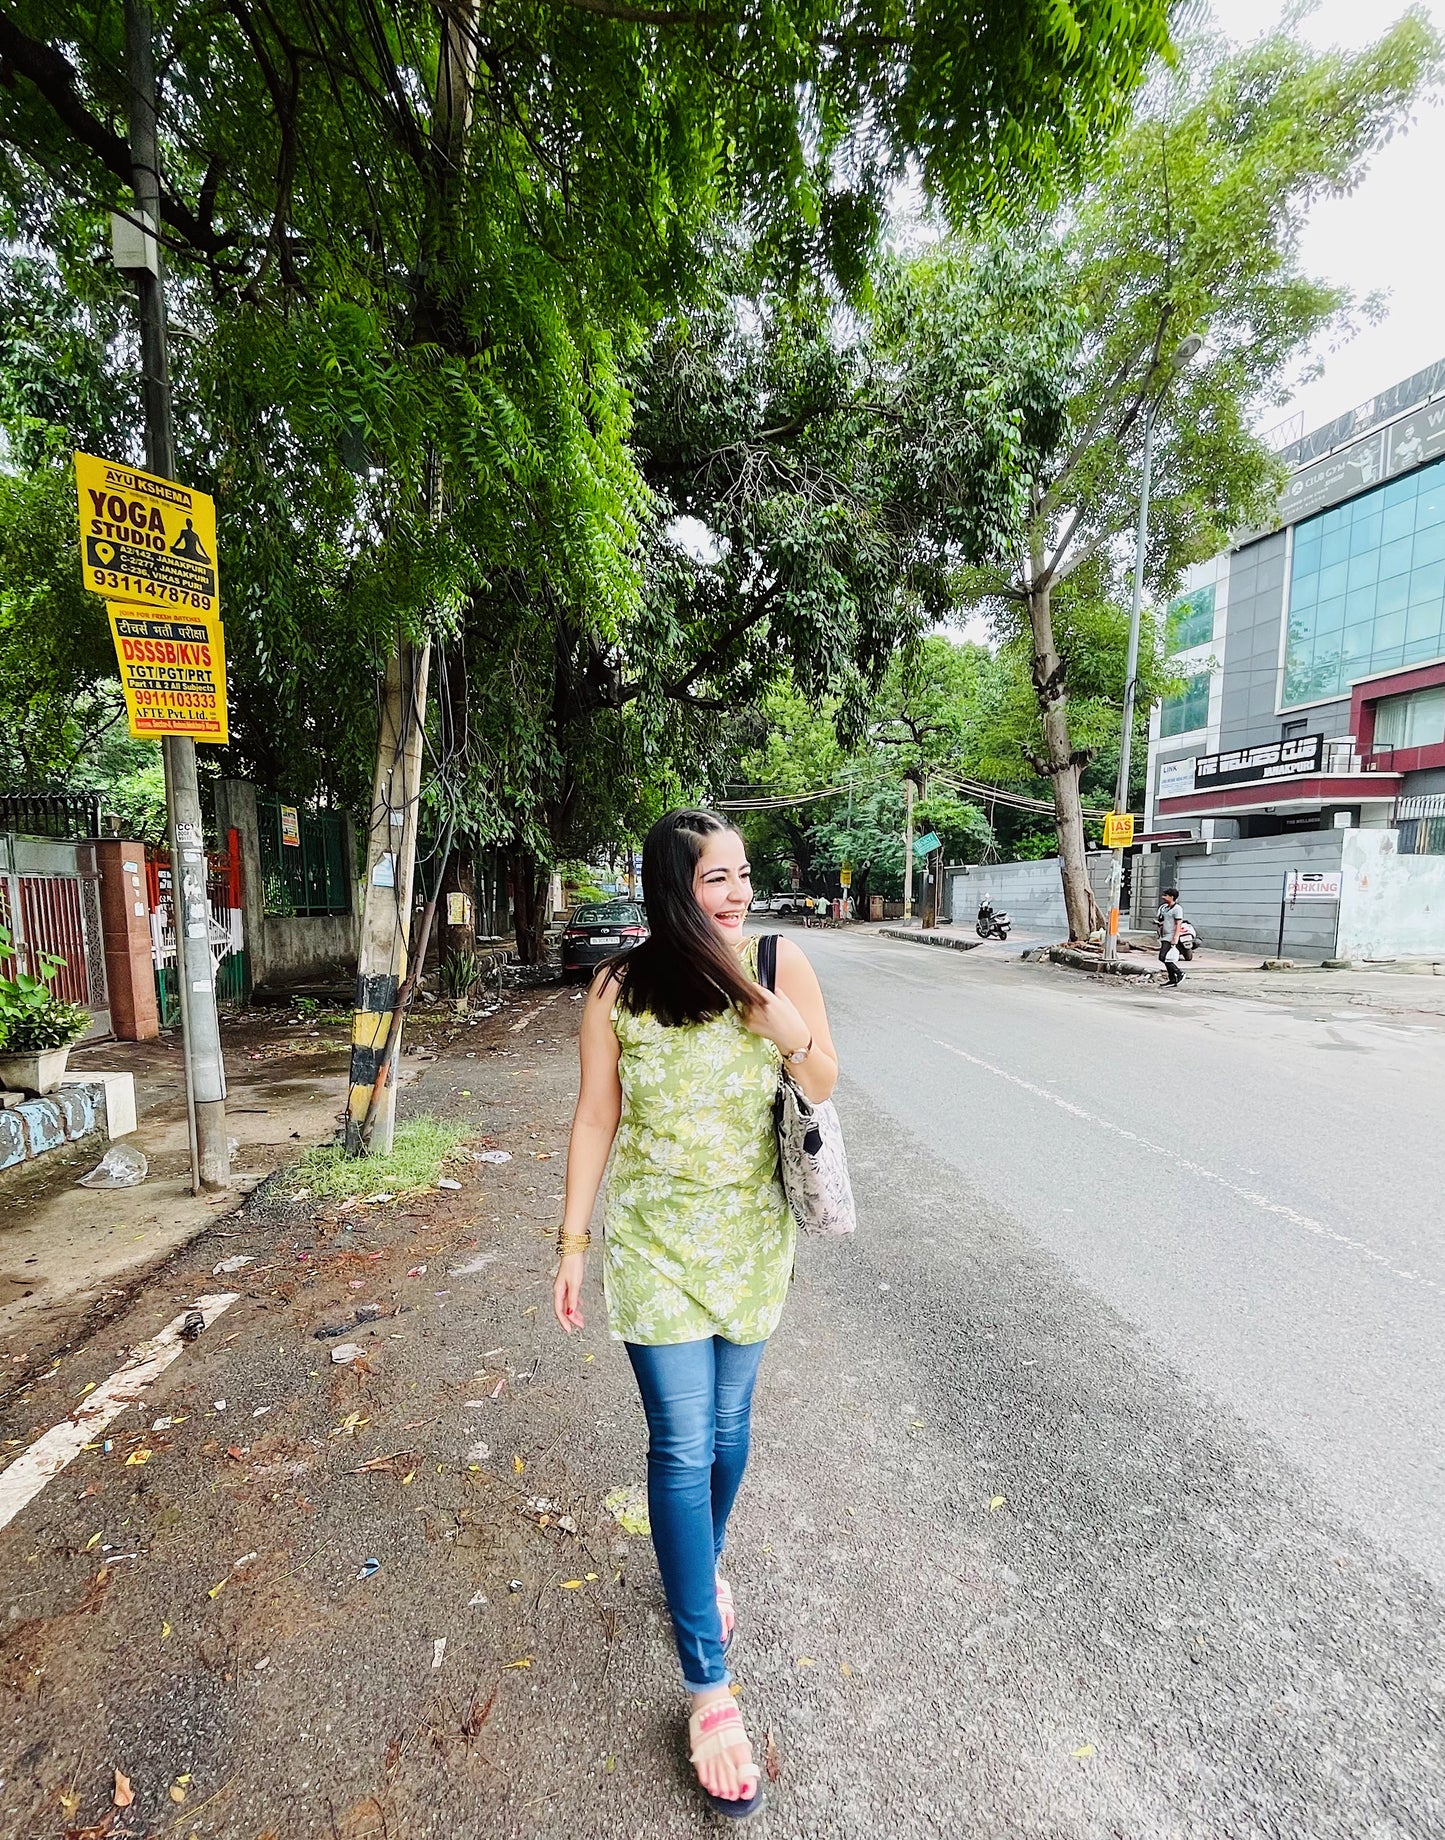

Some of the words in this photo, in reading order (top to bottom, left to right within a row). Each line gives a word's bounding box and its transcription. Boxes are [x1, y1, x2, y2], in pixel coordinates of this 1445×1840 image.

[1305, 472, 1325, 487] CLUB
[1325, 461, 1346, 478] GYM
[106, 470, 132, 486] AYU
[138, 479, 191, 506] KSHEMA
[88, 488, 166, 536] YOGA
[91, 519, 166, 552] STUDIO
[156, 555, 207, 575] JANAKPURI
[159, 564, 209, 584] JANAKPURI
[94, 569, 211, 611] 9311478789
[152, 571, 180, 584] VIKAS
[182, 579, 203, 591] PURI
[178, 625, 206, 640] परीक्षा
[129, 680, 146, 688] Part
[170, 682, 180, 690] All
[182, 683, 214, 692] Subjects
[135, 690, 216, 709] 9911103333
[135, 707, 165, 718] AFTE
[167, 708, 186, 719] Pvt.
[188, 709, 208, 720] Ltd.
[1197, 756, 1218, 777] THE
[1219, 744, 1281, 773] WELLNESS
[1281, 737, 1318, 762] CLUB
[1262, 759, 1315, 778] JANAKPURI
[1111, 820, 1132, 831] IAS
[1287, 883, 1338, 892] PARKING
